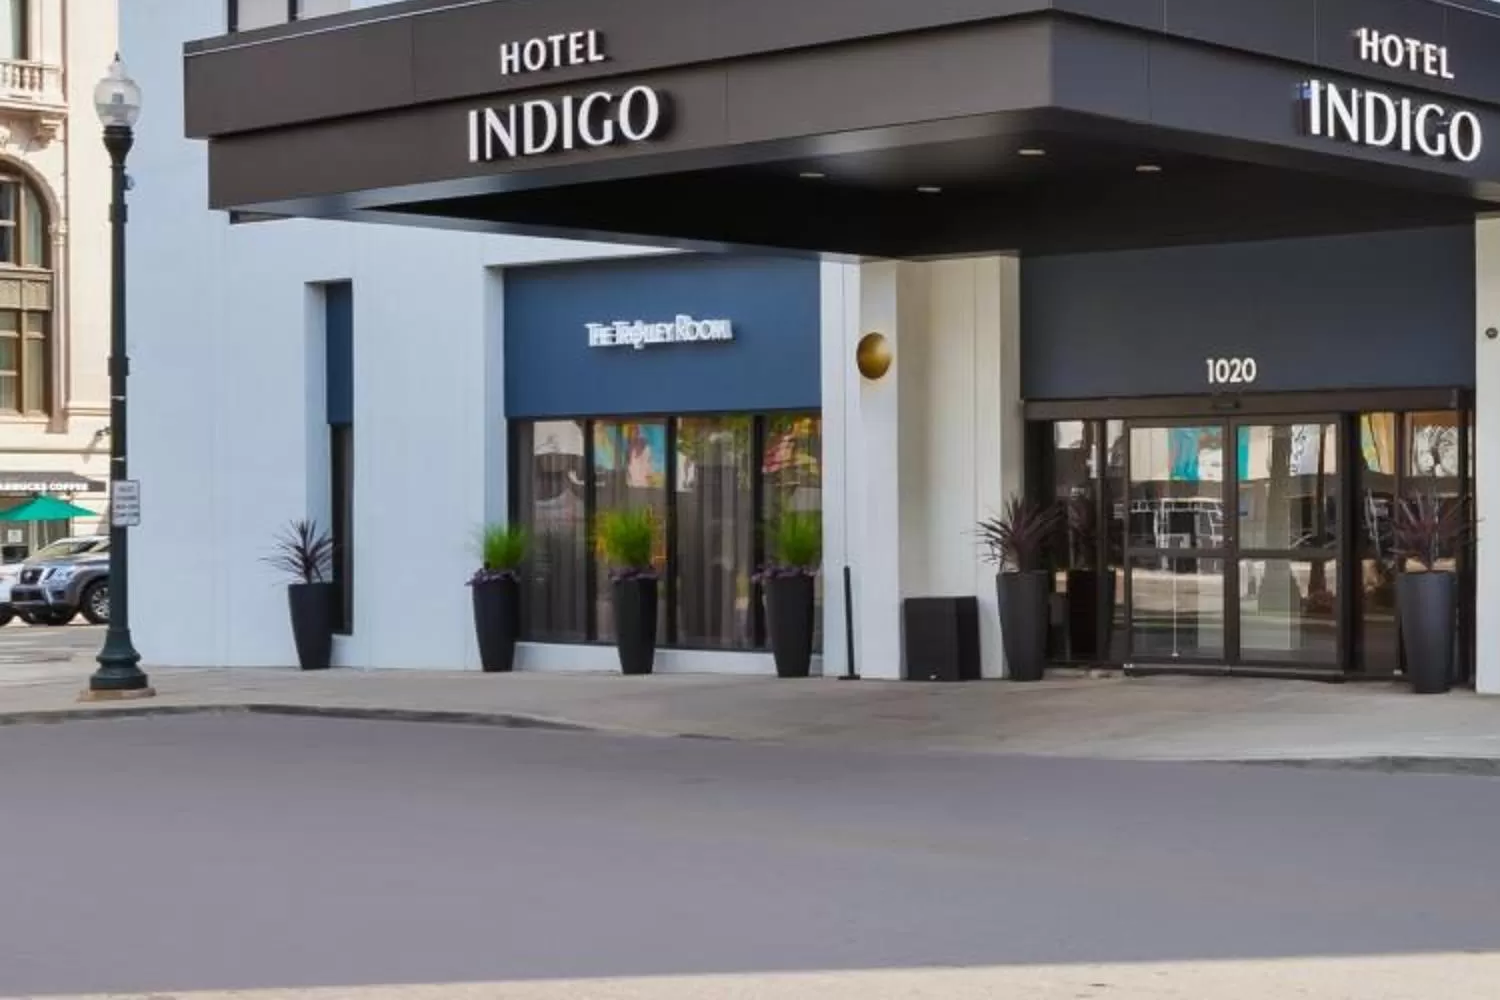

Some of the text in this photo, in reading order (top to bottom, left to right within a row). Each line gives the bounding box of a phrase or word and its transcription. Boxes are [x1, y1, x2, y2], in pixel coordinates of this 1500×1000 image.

[500, 29, 604, 75] HOTEL
[1357, 27, 1455, 79] HOTEL
[468, 85, 659, 162] INDIGO
[1306, 79, 1483, 162] INDIGO
[675, 314, 733, 341] ROOM
[1206, 357, 1257, 384] 1020
